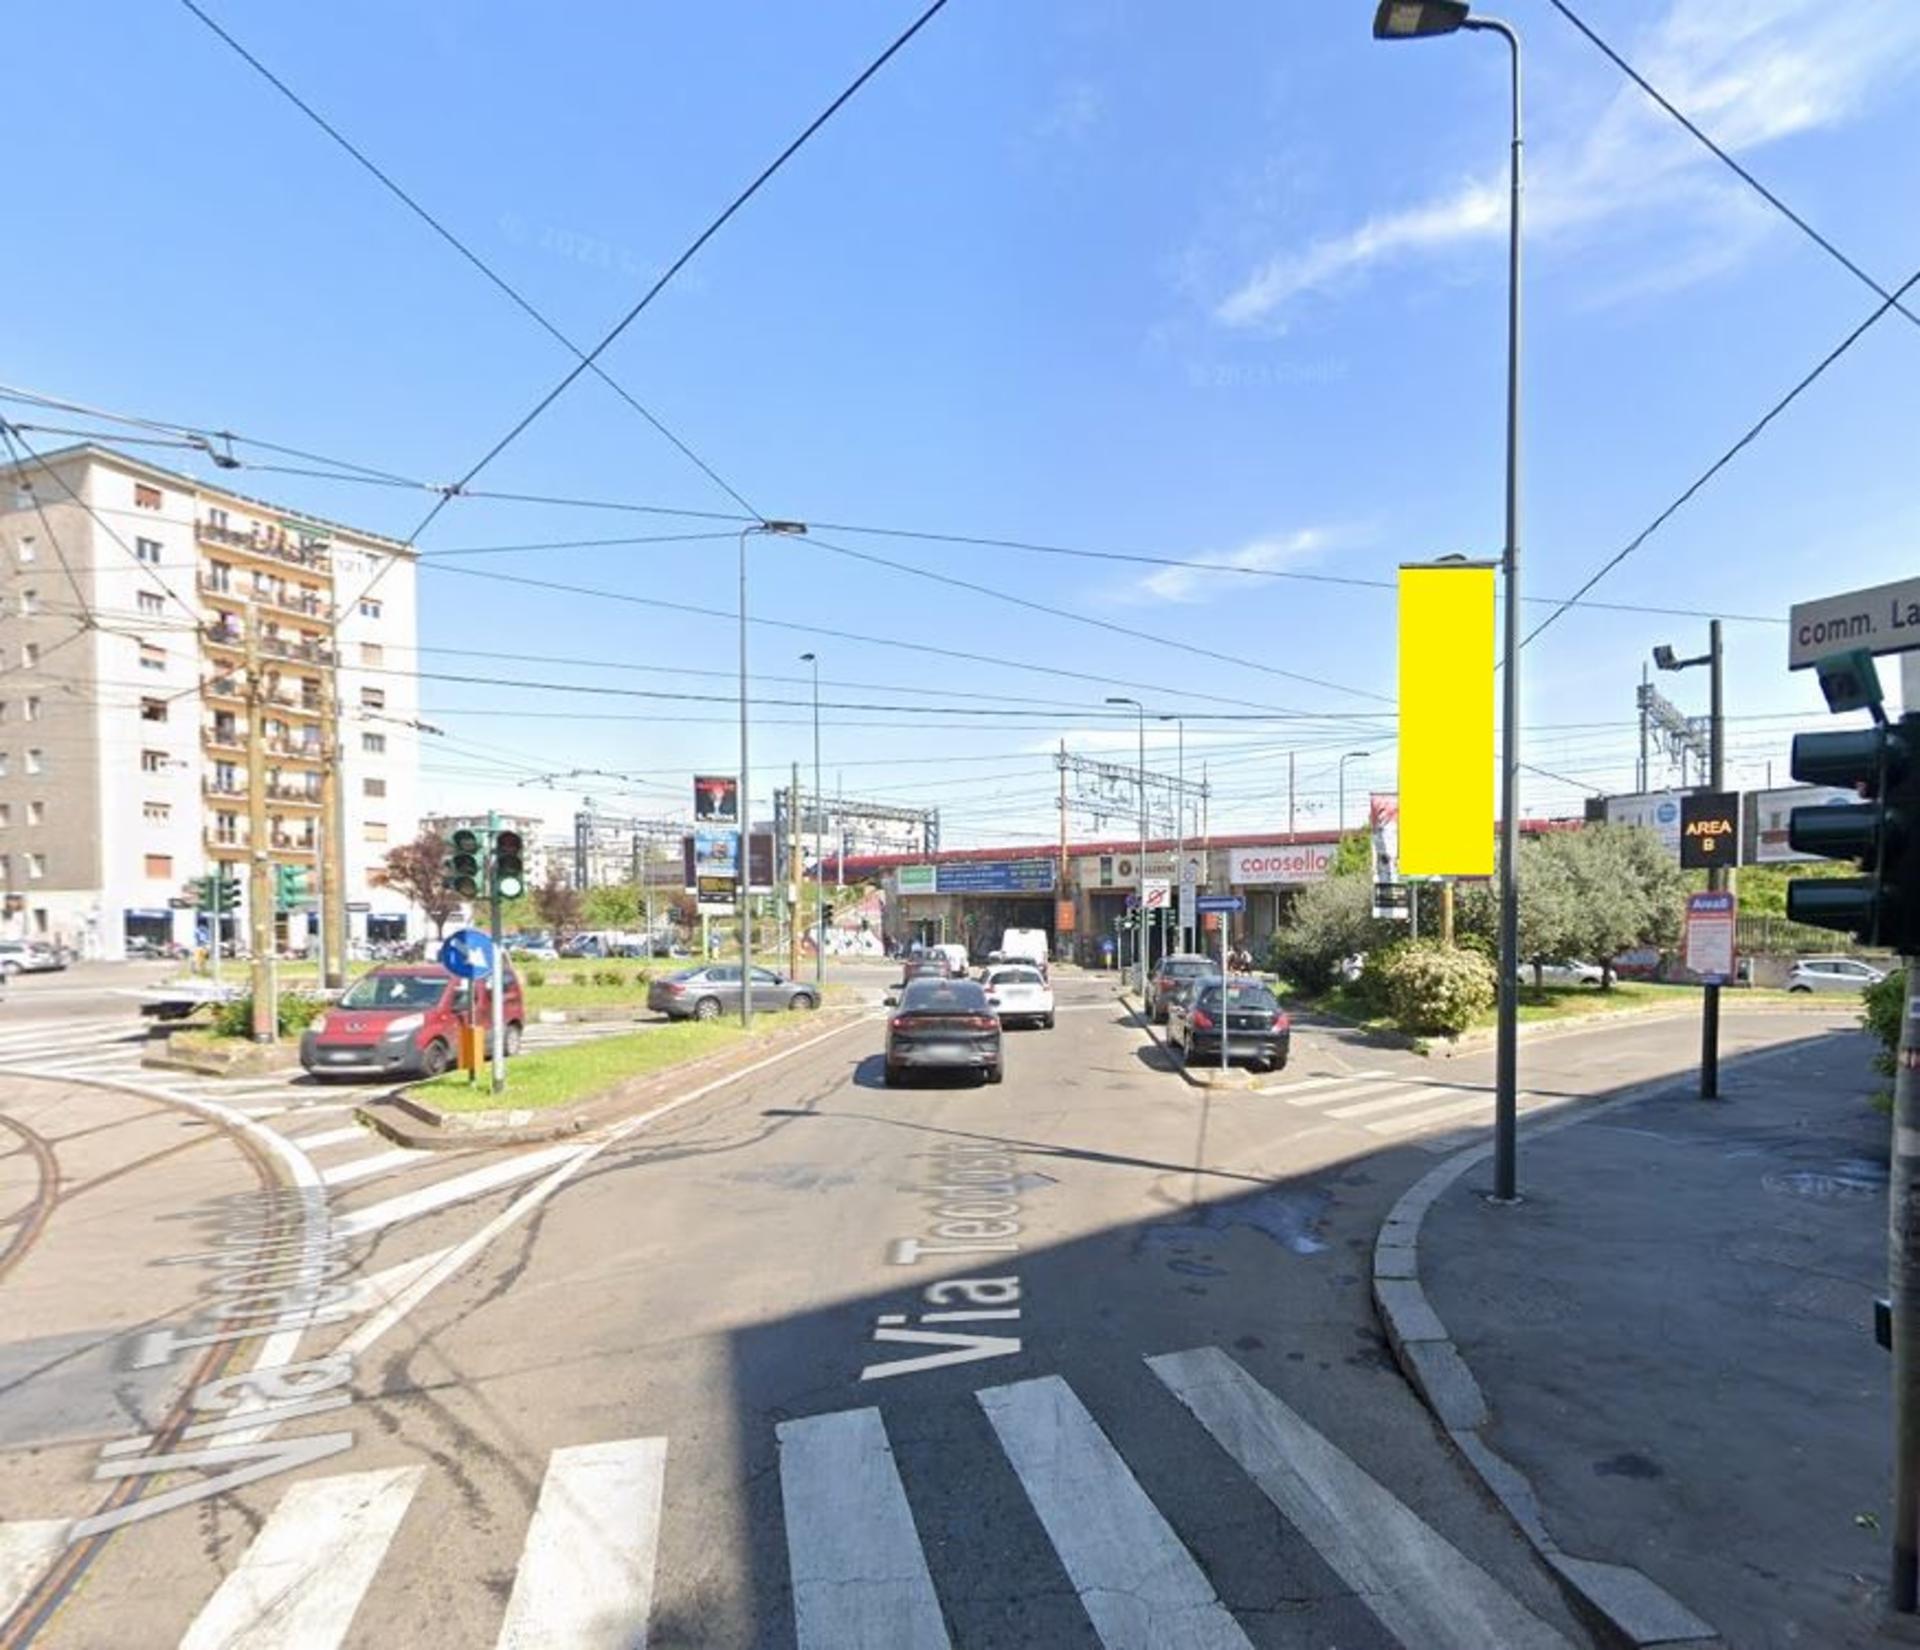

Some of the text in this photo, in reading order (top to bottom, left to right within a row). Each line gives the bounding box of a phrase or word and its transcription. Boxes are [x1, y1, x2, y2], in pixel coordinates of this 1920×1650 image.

[1799, 613, 1877, 646] comm.
[1685, 819, 1733, 836] AREA
[1240, 847, 1329, 873] carosello
